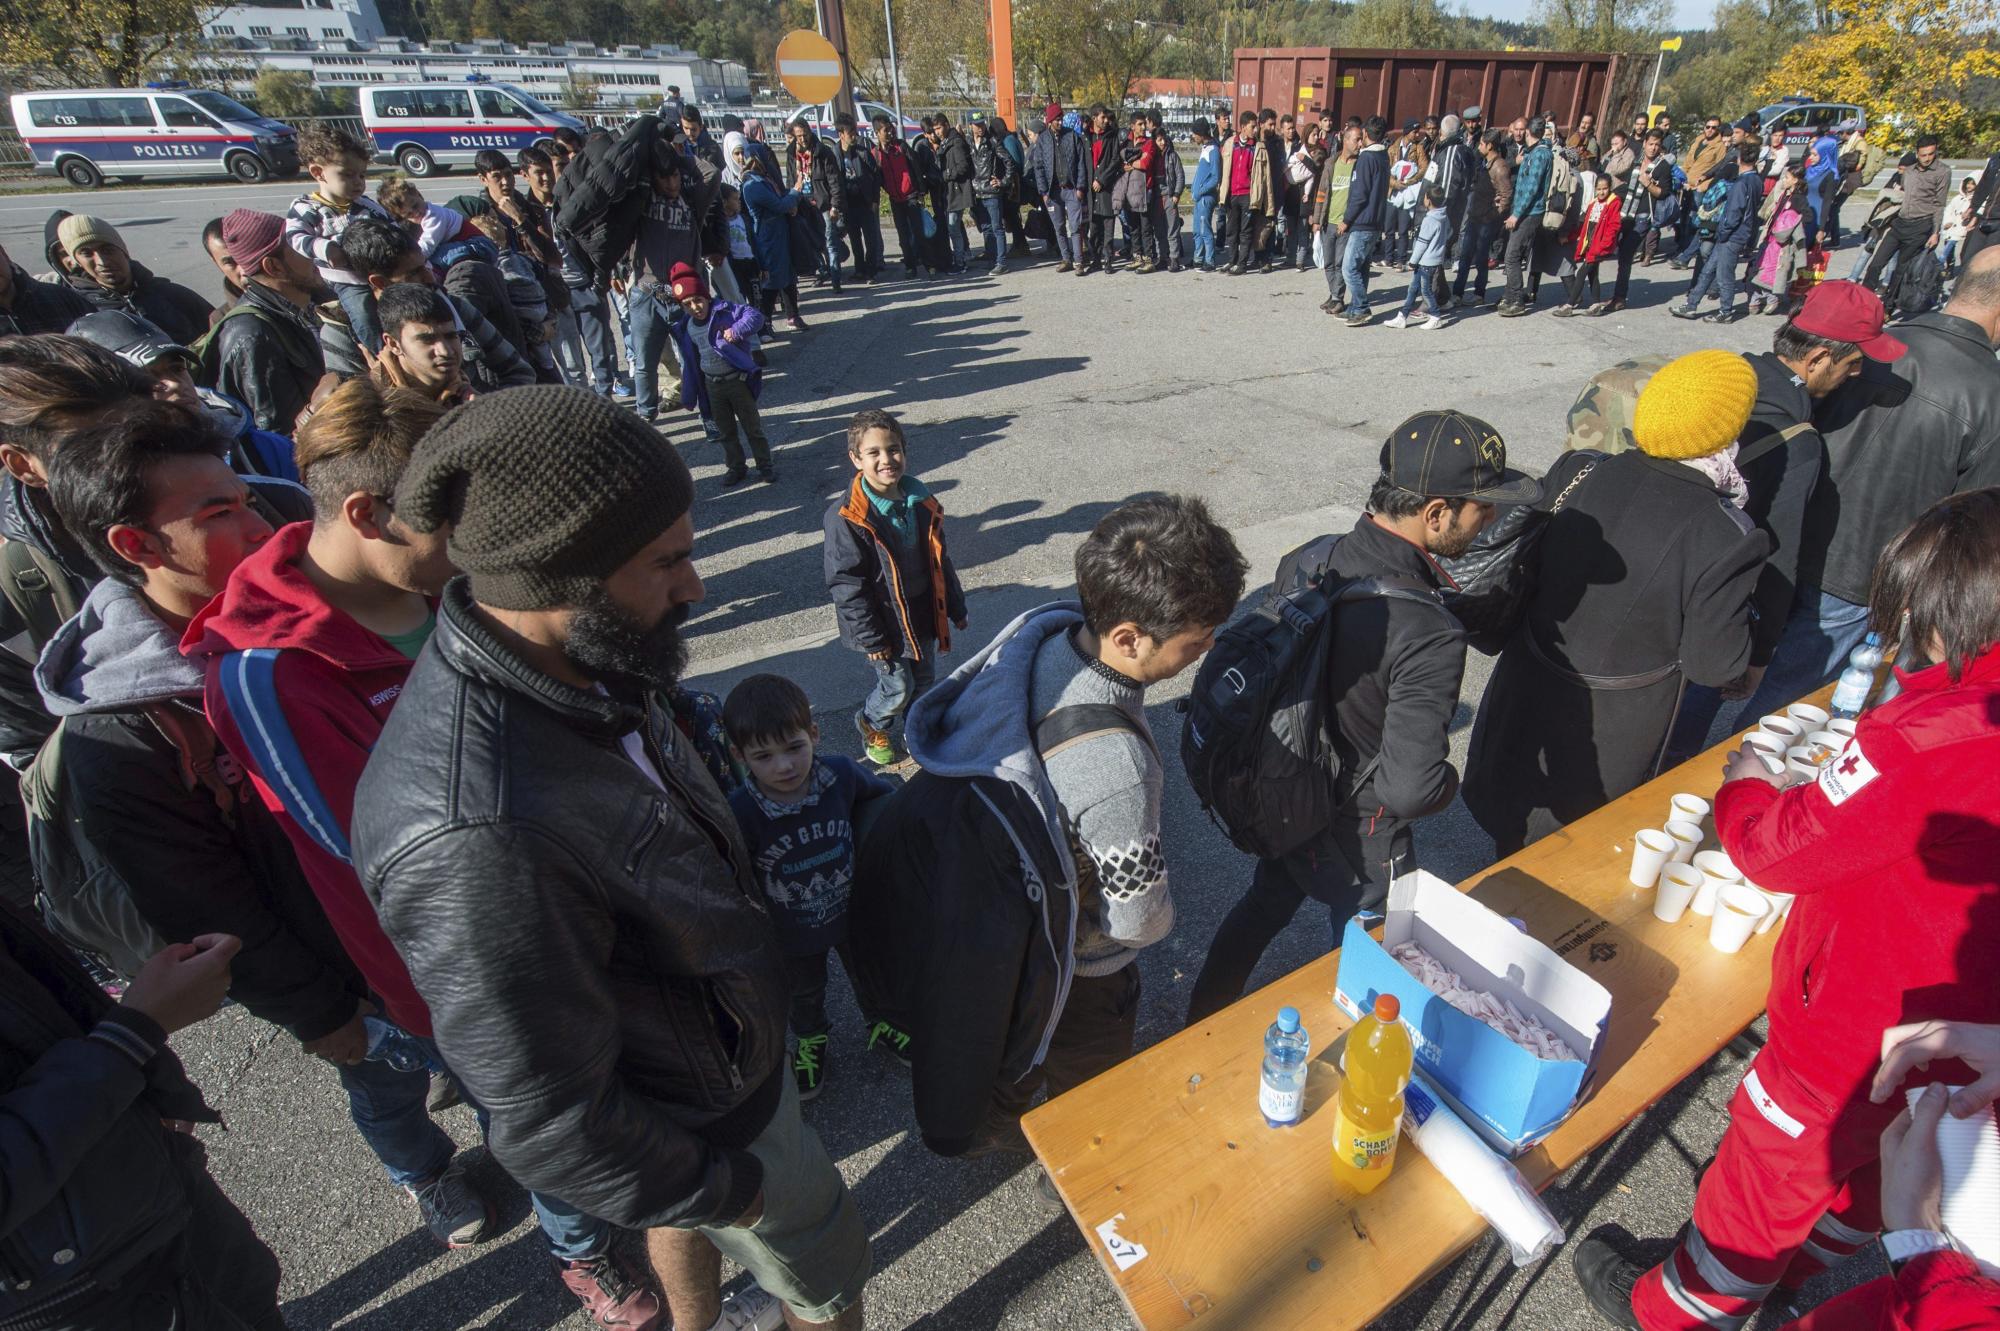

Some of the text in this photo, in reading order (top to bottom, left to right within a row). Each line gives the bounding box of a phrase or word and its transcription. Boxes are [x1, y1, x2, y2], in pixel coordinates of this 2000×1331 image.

[394, 106, 408, 116] 133
[61, 114, 77, 126] 133
[450, 135, 510, 147] POLIZEI
[1785, 136, 1810, 144] POLIZ
[133, 145, 198, 157] POLIZEI
